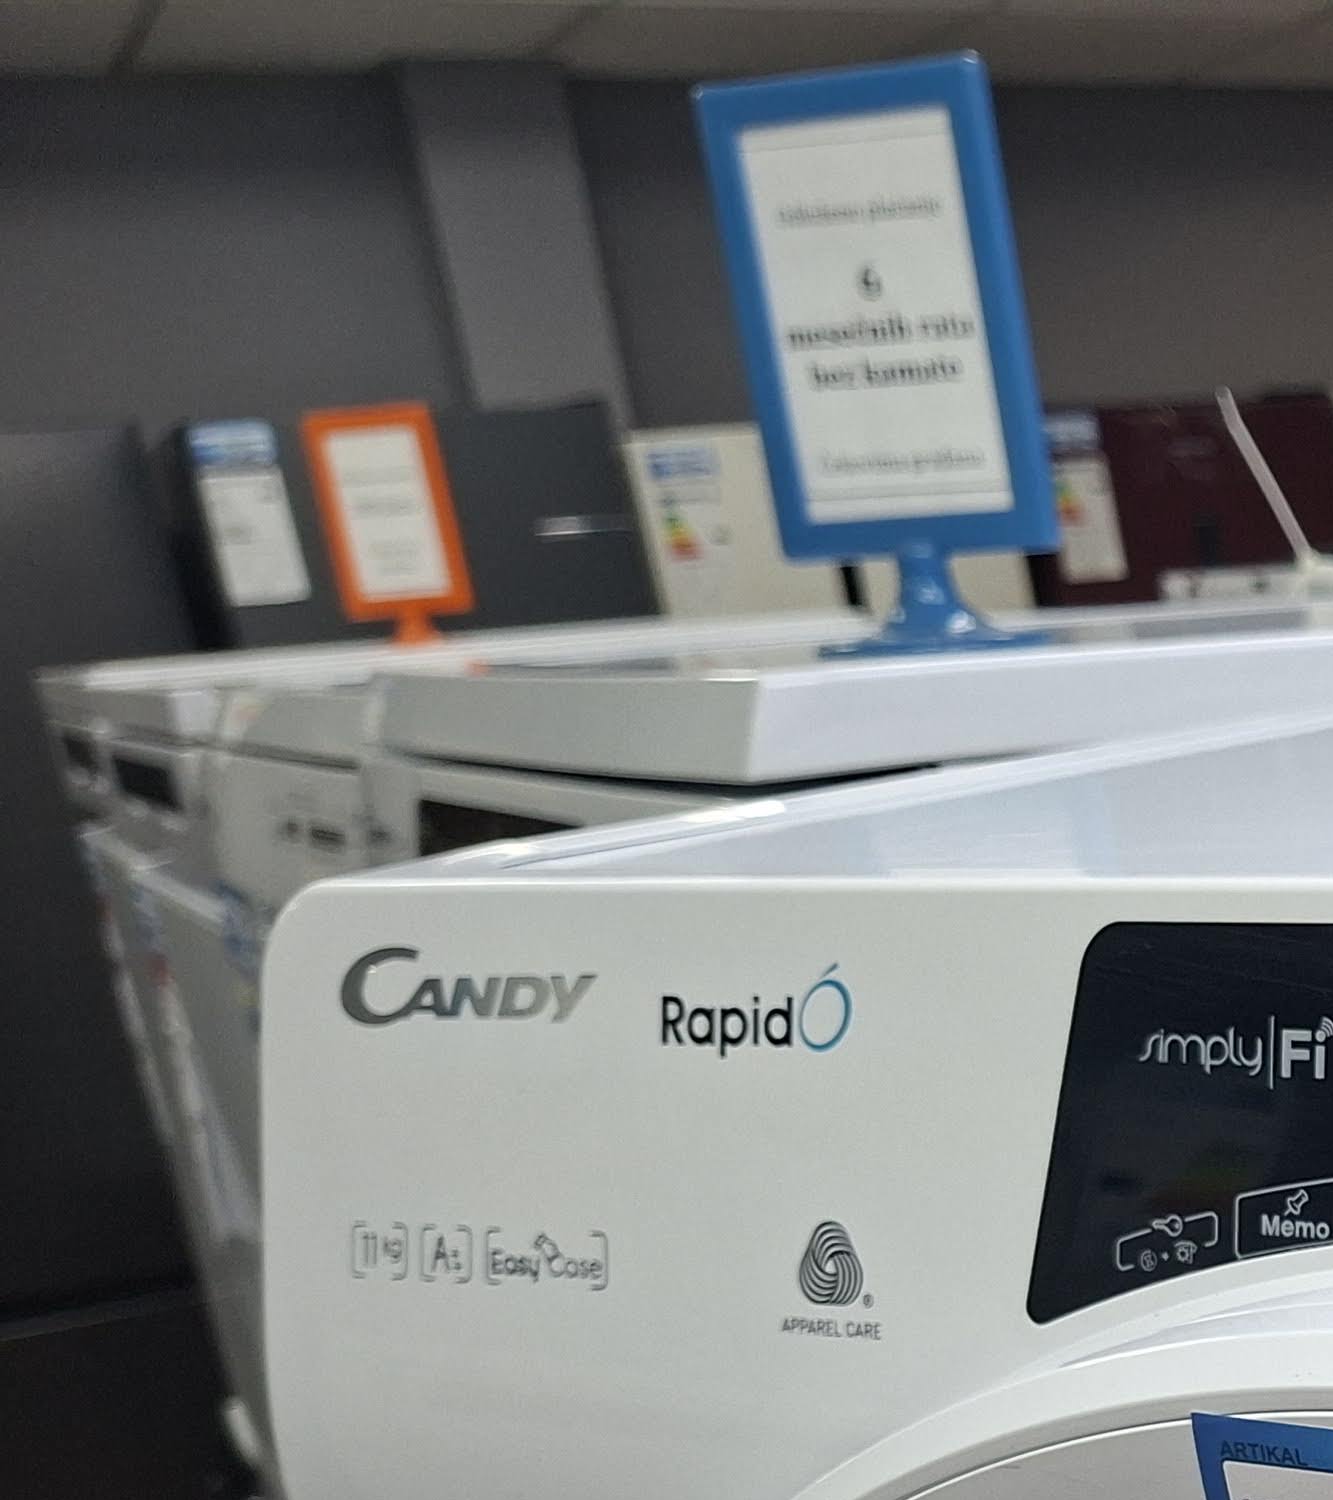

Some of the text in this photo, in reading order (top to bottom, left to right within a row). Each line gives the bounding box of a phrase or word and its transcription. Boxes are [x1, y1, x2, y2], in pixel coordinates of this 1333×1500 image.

[1261, 1212, 1331, 1240] Memo
[781, 1317, 882, 1341] APPAREL CARE
[1219, 1439, 1309, 1468] ARTIKAL
